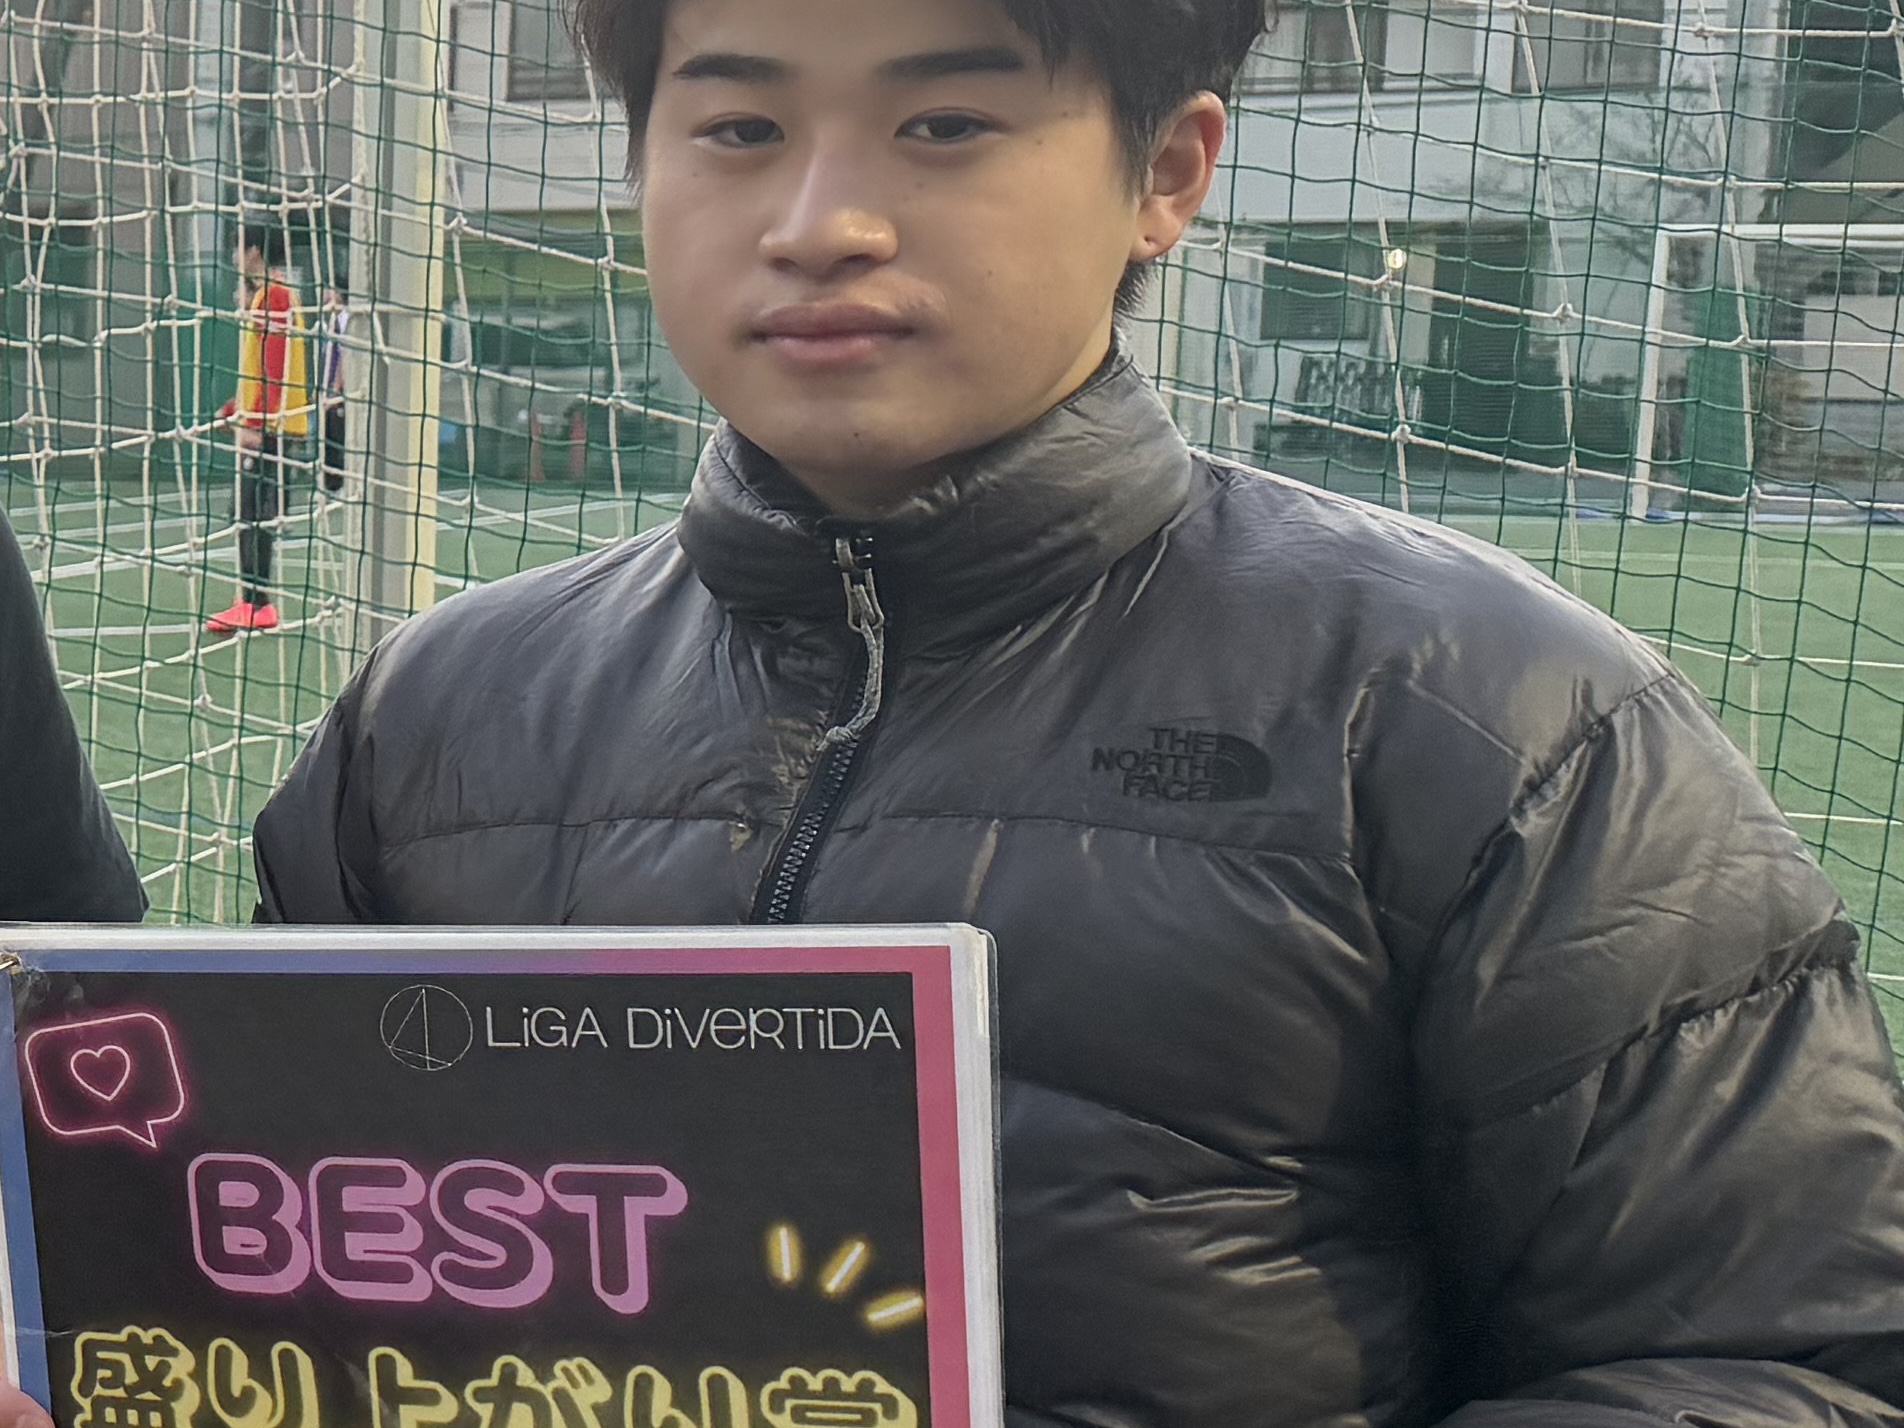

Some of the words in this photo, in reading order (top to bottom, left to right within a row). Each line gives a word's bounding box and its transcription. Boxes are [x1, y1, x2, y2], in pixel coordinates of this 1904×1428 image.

[1148, 728, 1217, 754] THE
[1092, 747, 1211, 779] NORTH
[1123, 773, 1211, 802] FACE
[186, 1151, 688, 1315] BEST
